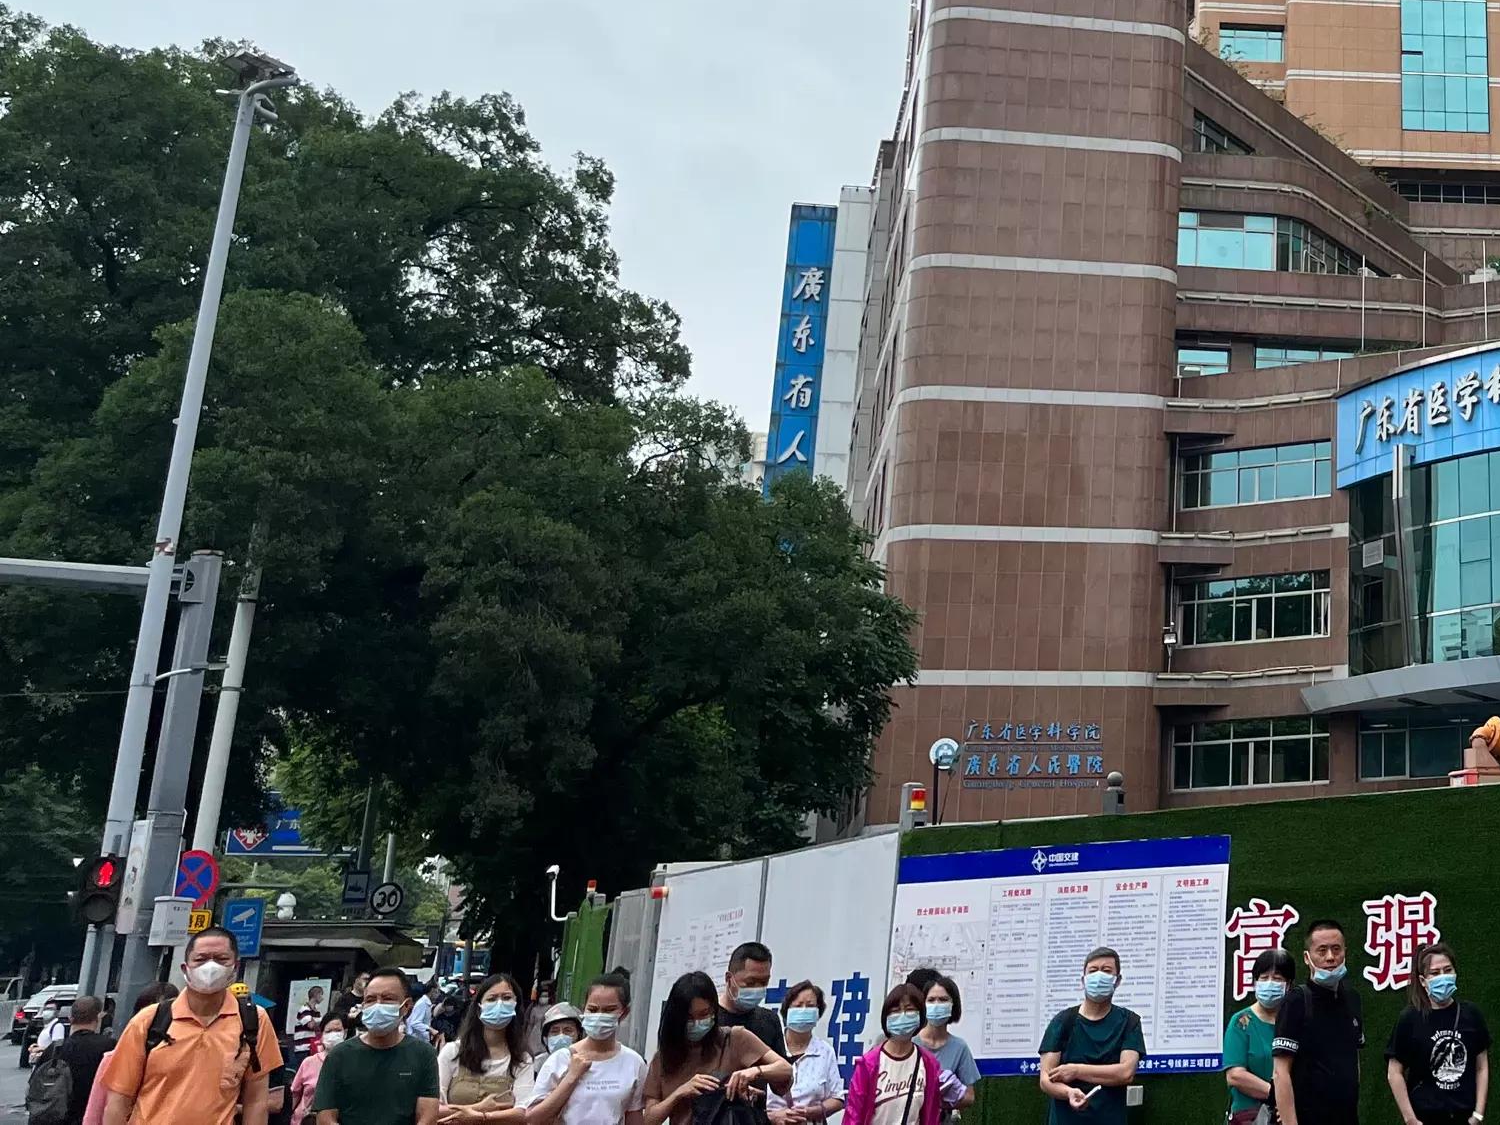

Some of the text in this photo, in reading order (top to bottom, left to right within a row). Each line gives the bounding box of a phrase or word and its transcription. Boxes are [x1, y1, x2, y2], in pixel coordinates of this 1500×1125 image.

[965, 719, 1102, 742] 广东省医学科学院
[375, 890, 398, 908] 30
